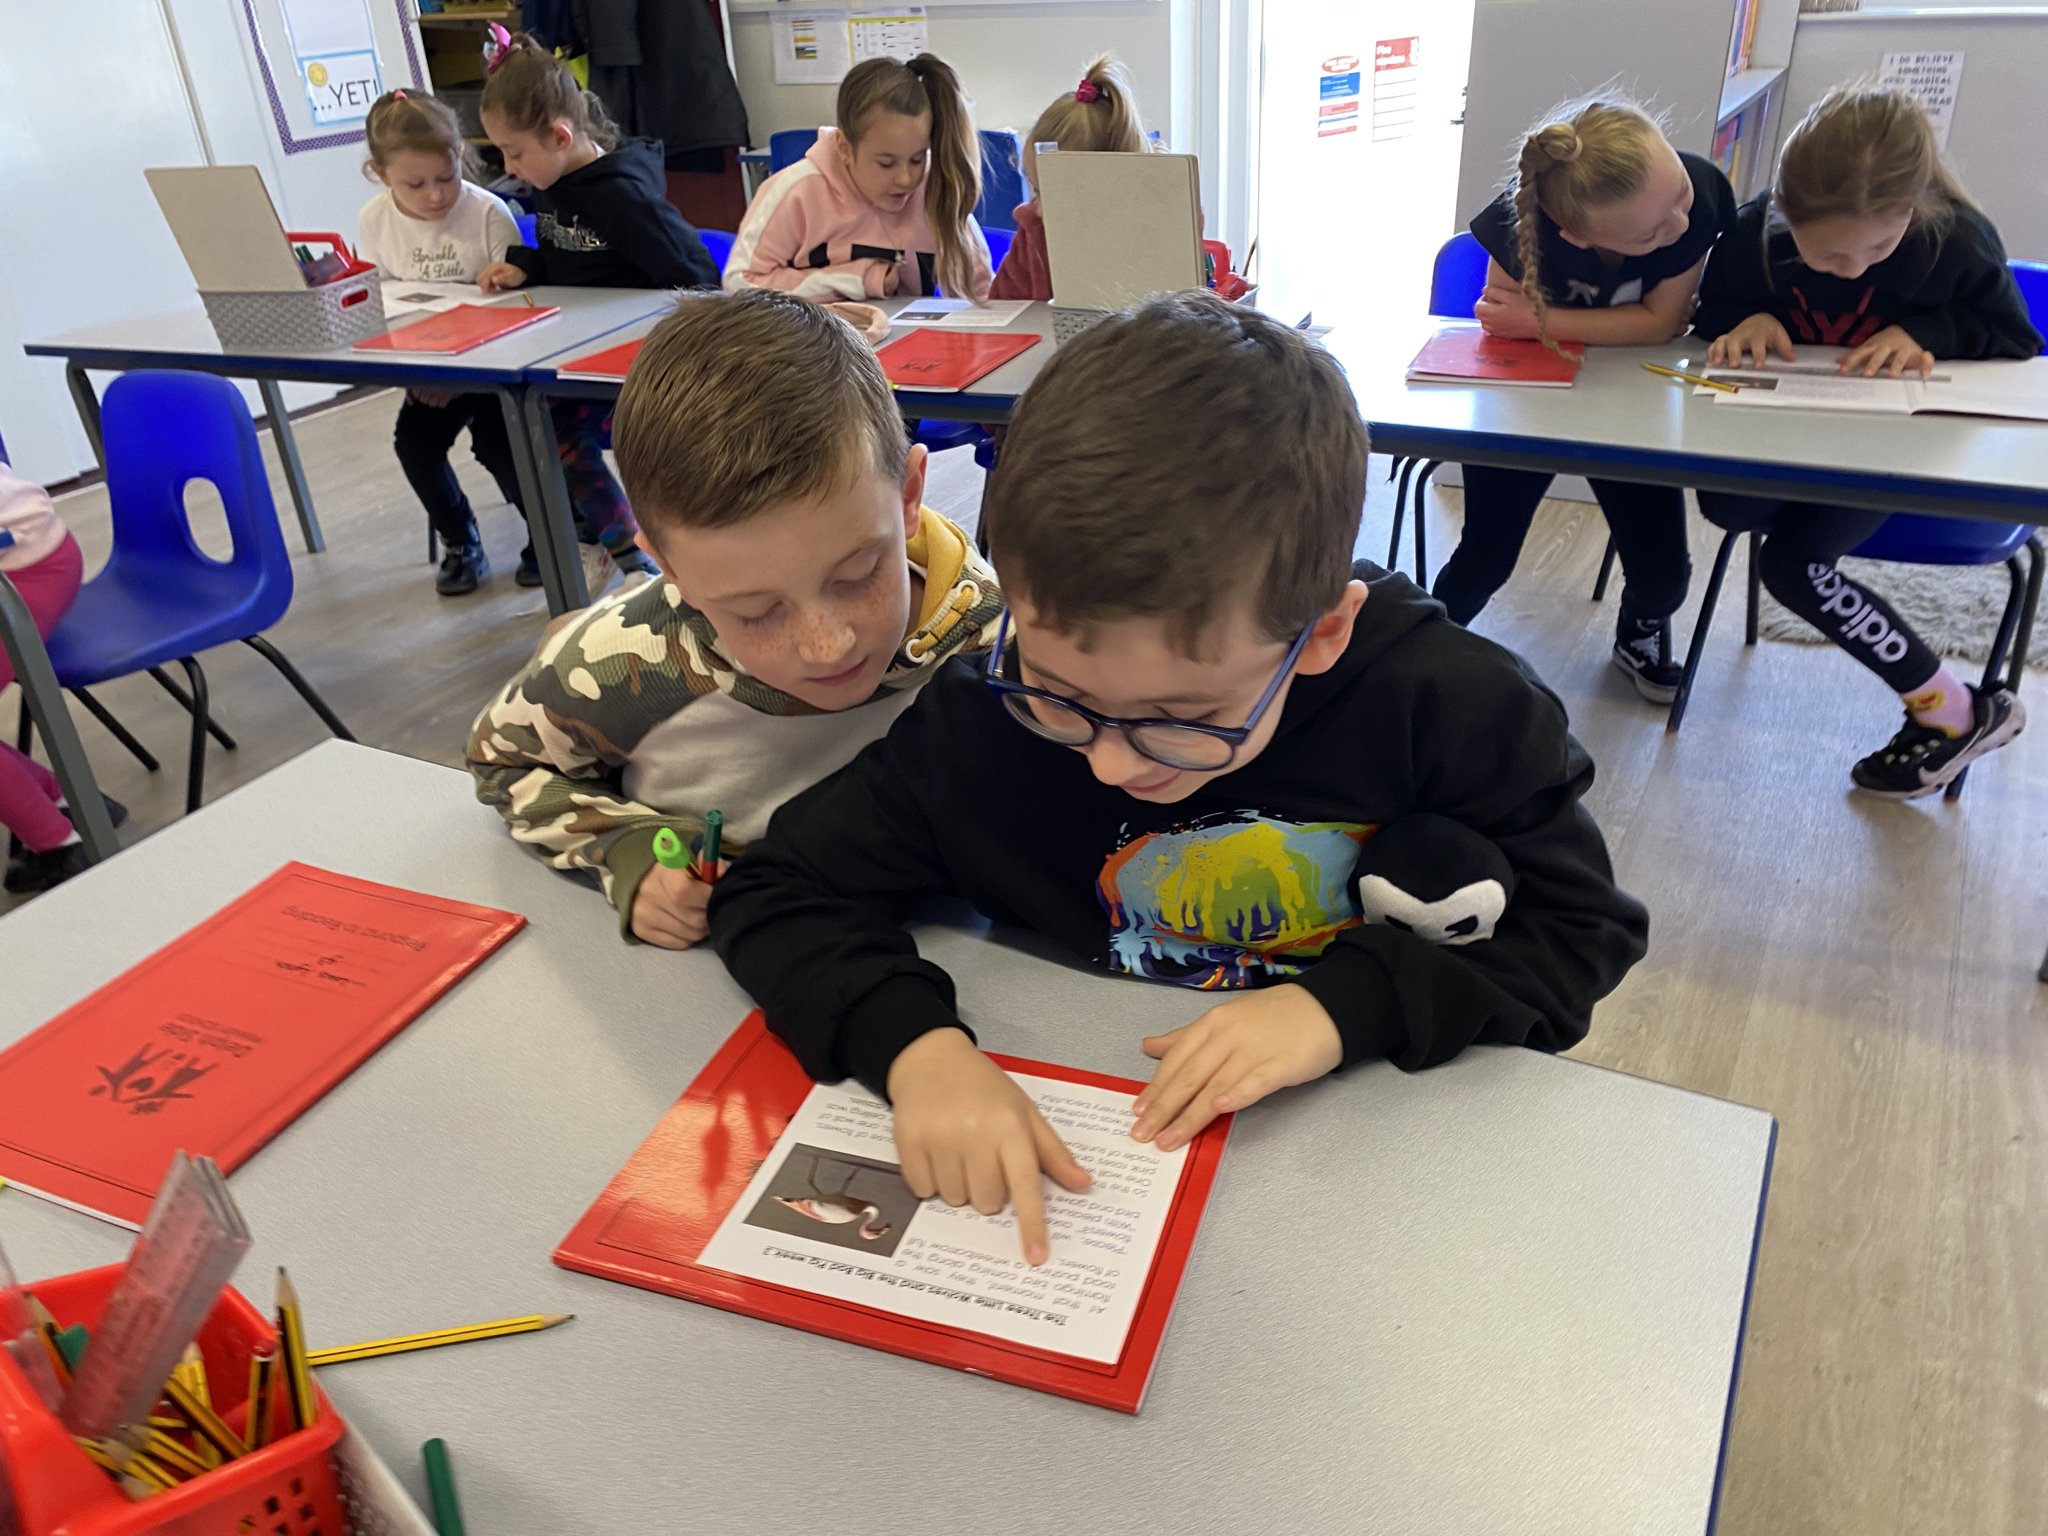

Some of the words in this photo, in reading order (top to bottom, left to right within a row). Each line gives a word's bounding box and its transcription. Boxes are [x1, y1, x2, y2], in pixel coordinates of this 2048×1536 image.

[1915, 55, 1954, 64] BELIEVE
[1898, 66, 1948, 74] SOMETHING
[1910, 76, 1952, 84] MAGICAL
[412, 243, 457, 271] Sprinkle
[418, 264, 430, 280] A
[433, 261, 465, 278] Little
[1807, 562, 1909, 663] adidas
[280, 905, 341, 931] Reading
[826, 1104, 848, 1112] was
[849, 1107, 887, 1120] ceiling
[1053, 1108, 1088, 1118] rather
[1092, 1104, 1117, 1115] very
[856, 1121, 880, 1129] one
[1051, 1117, 1075, 1127] lilies
[1099, 1116, 1122, 1124] was
[1076, 1123, 1110, 1133] water
[1098, 1159, 1128, 1170] roses
[1123, 1153, 1160, 1165] made
[1098, 1170, 1122, 1180] wall
[1130, 1165, 1157, 1175] pink
[1125, 1175, 1152, 1187] One
[1110, 1184, 1131, 1194] the
[1133, 1188, 1150, 1198] So
[1055, 1196, 1088, 1208] gave
[1088, 1203, 1114, 1213] and
[925, 1204, 959, 1216] some
[1114, 1208, 1140, 1220] bird
[986, 1218, 1013, 1228] give
[1050, 1232, 1071, 1240] will
[906, 1238, 927, 1248] full
[772, 1250, 806, 1262] week
[900, 1249, 924, 1260] the
[928, 1244, 1010, 1266] wheelbarrow
[808, 1257, 827, 1269] Pig
[895, 1260, 907, 1268] a
[927, 1254, 965, 1268] along
[1057, 1258, 1104, 1275] flowers.
[828, 1264, 853, 1275] Bad
[856, 1267, 874, 1280] Big
[912, 1266, 941, 1276] saw
[968, 1263, 1018, 1281] coming
[878, 1275, 898, 1286] the
[946, 1272, 977, 1286] they
[1020, 1276, 1048, 1289] bird
[1082, 1278, 1117, 1290] road
[898, 1280, 926, 1291] and
[987, 1281, 1045, 1300] moment,
[928, 1286, 971, 1304] Wolves
[1052, 1284, 1112, 1304] flamingo
[975, 1298, 1004, 1311] Little
[1052, 1297, 1080, 1309] that
[1006, 1304, 1040, 1320] Three
[1044, 1314, 1067, 1326] The
